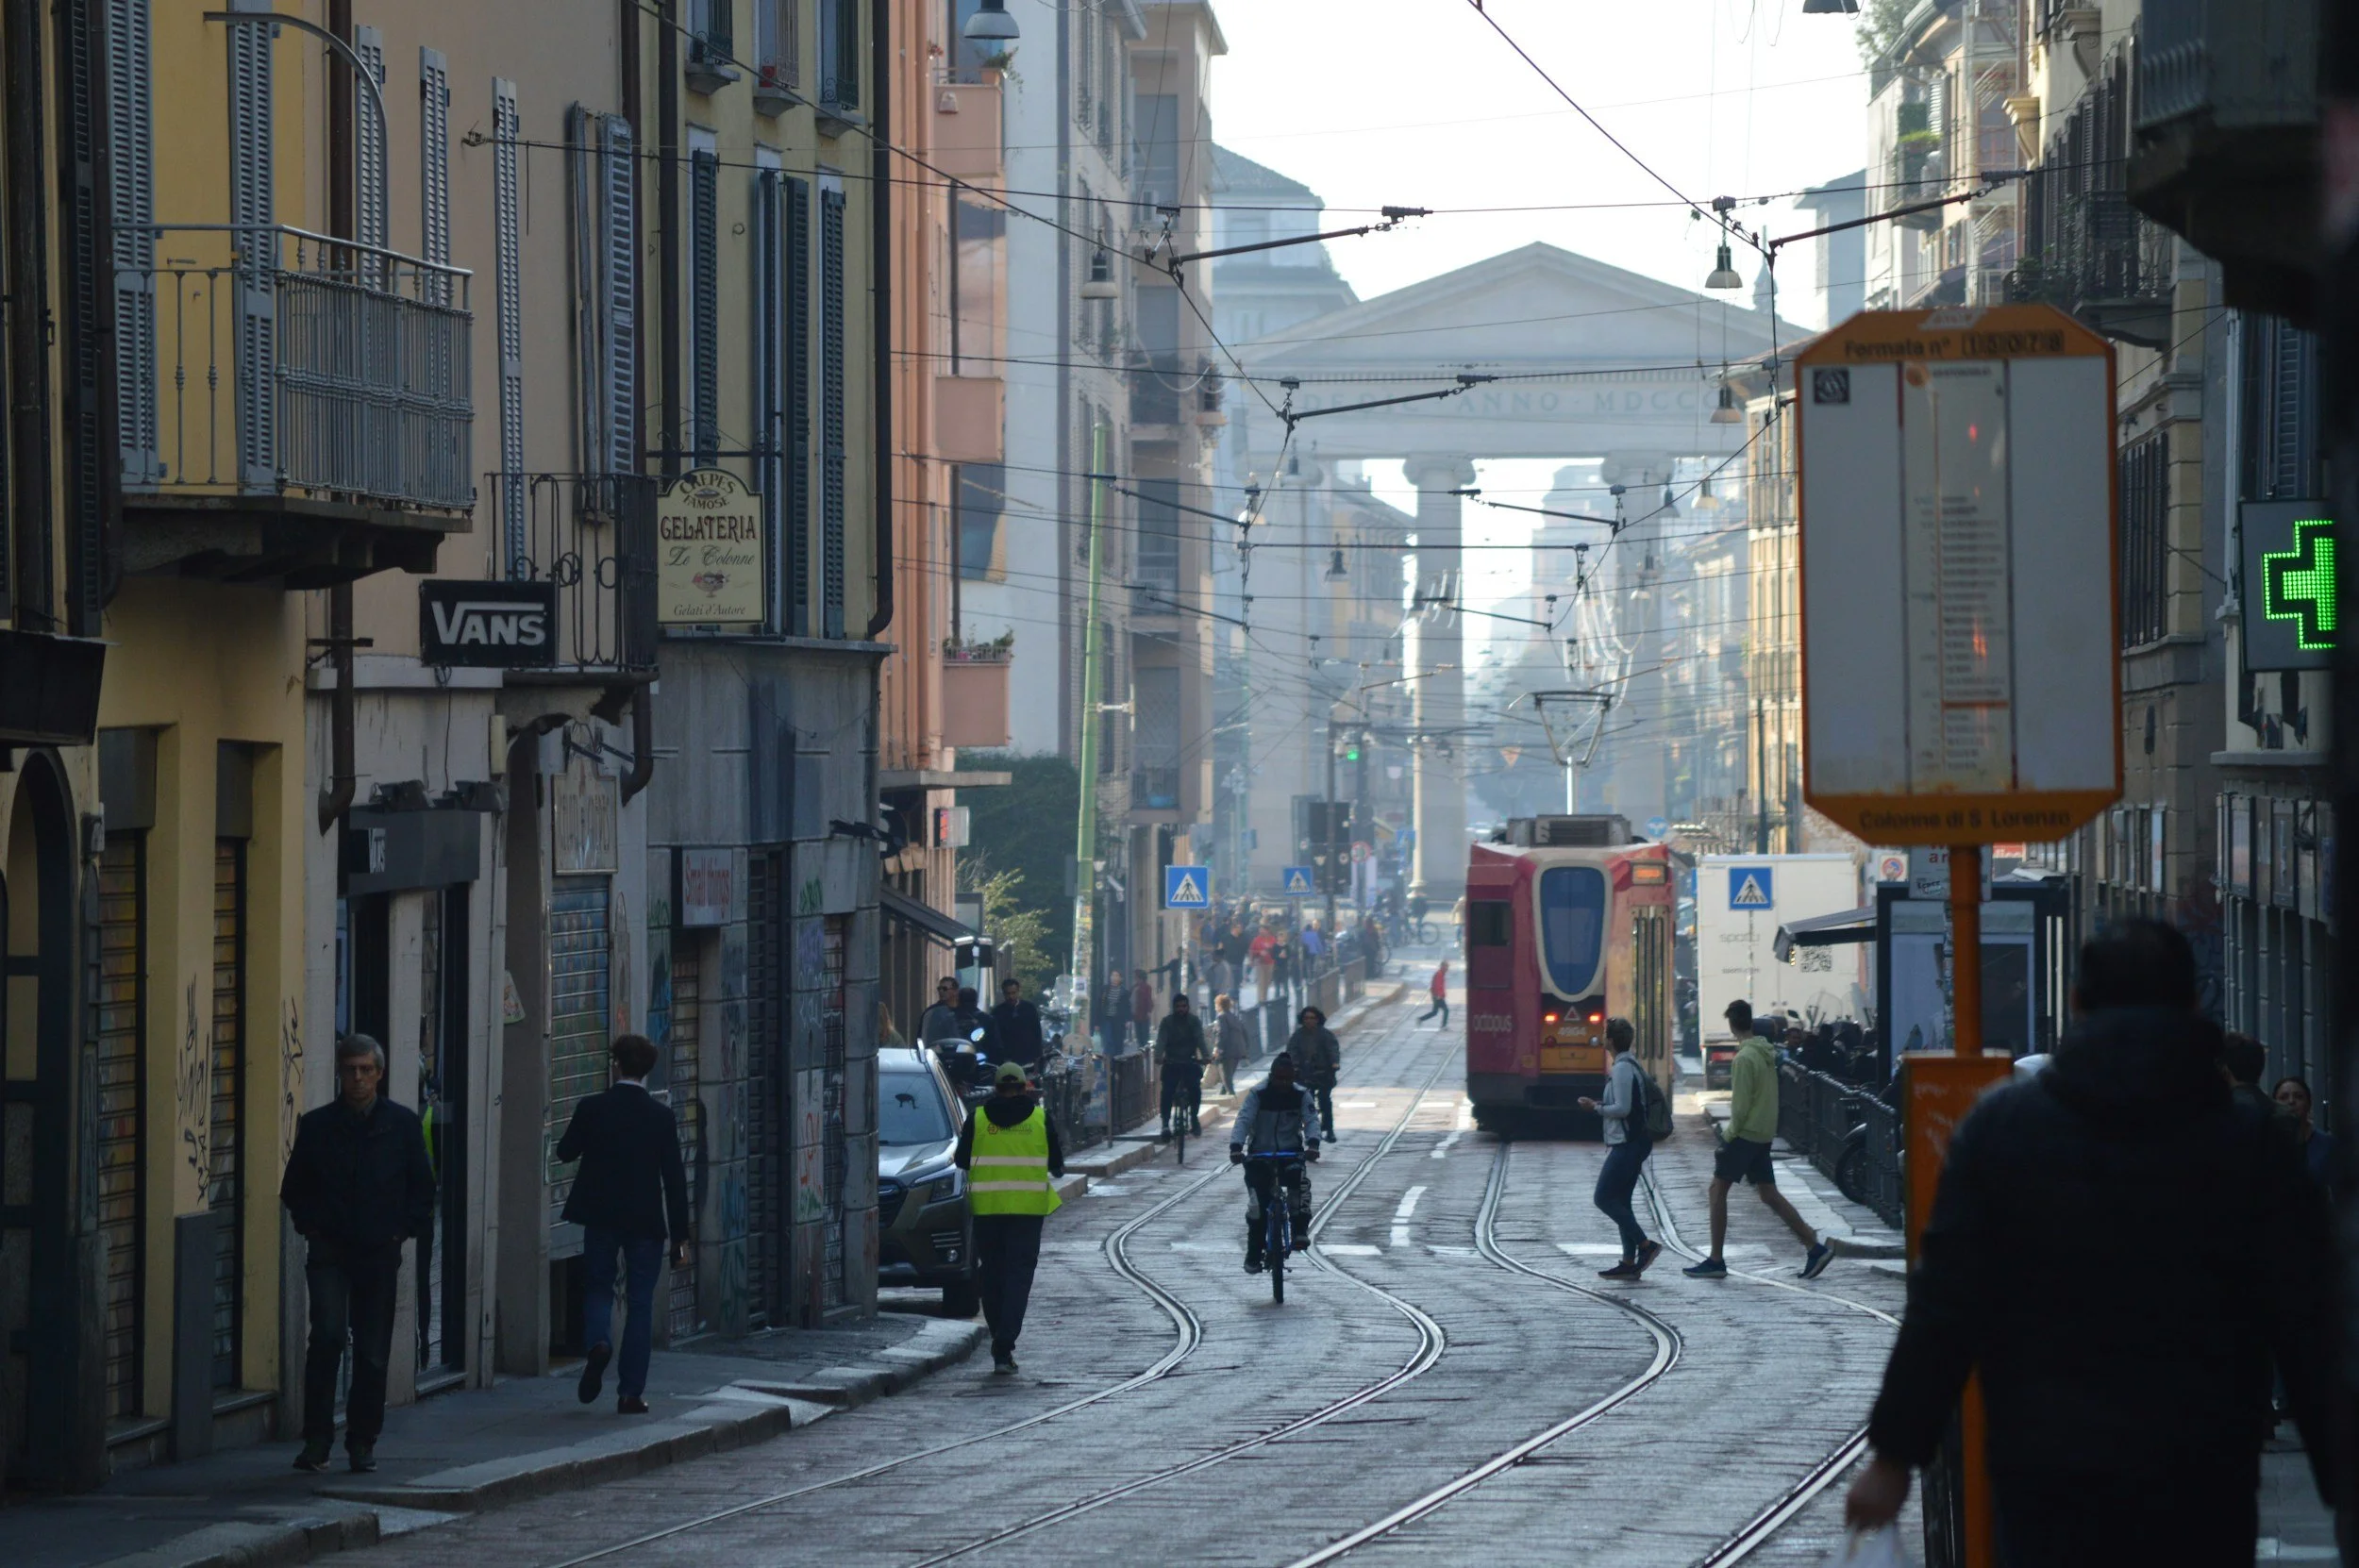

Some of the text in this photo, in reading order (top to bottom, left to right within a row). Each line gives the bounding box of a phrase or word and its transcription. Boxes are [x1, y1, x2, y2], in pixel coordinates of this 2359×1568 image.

[1845, 340, 1924, 358] Fermata
[1459, 391, 1559, 413] ANNO
[683, 495, 730, 509] FAMOSE
[661, 515, 757, 542] GELATERIA
[701, 544, 755, 567] Colonne
[674, 604, 746, 617] Gelati d'Autore
[431, 600, 546, 645] VANS
[1859, 810, 1938, 830] Colonne
[1946, 809, 1964, 828] di
[1991, 809, 2070, 828] Lorenzo
